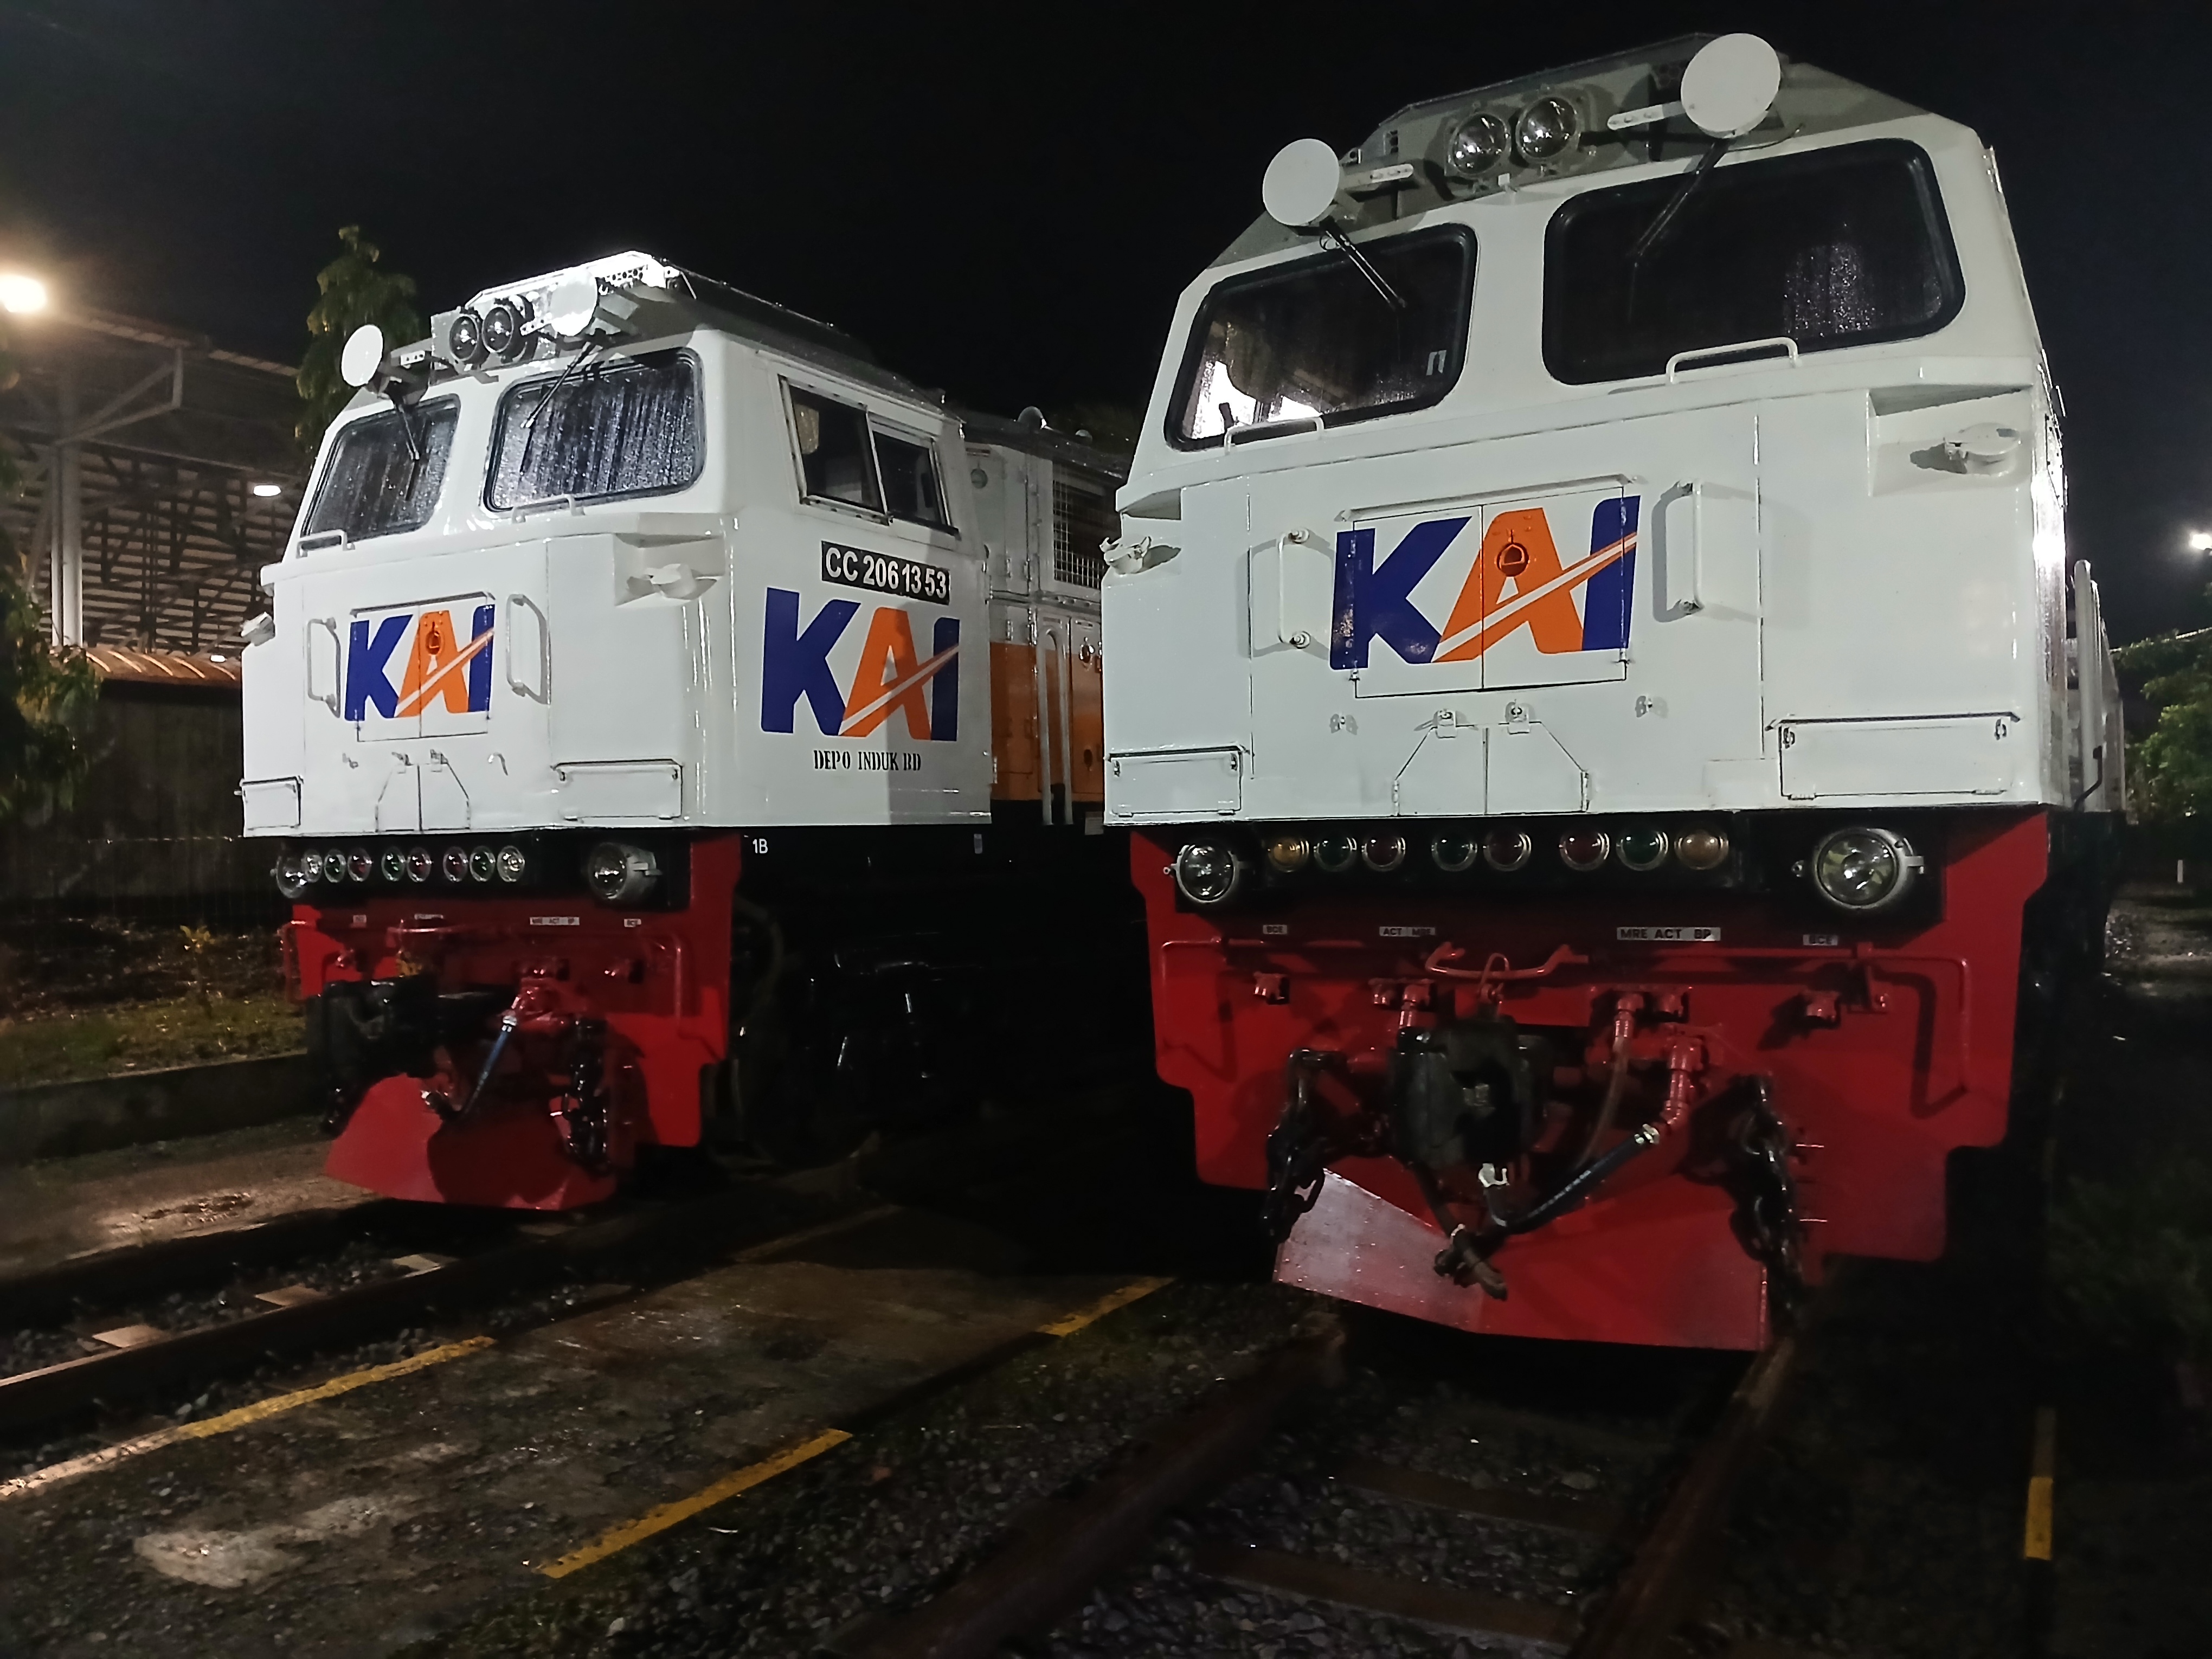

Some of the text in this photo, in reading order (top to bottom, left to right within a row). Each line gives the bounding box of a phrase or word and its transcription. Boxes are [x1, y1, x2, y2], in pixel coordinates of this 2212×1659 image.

[826, 547, 858, 581] CC
[863, 555, 899, 589] 206
[1329, 495, 1641, 670] KAI
[344, 604, 495, 721] KAI
[761, 587, 960, 741] KAI
[813, 750, 851, 769] DEPO
[858, 751, 899, 770] INDUK
[753, 838, 768, 854] 1B
[1383, 928, 1401, 936] ACT
[1621, 929, 1648, 939] MRE
[1654, 929, 1682, 939] ACT
